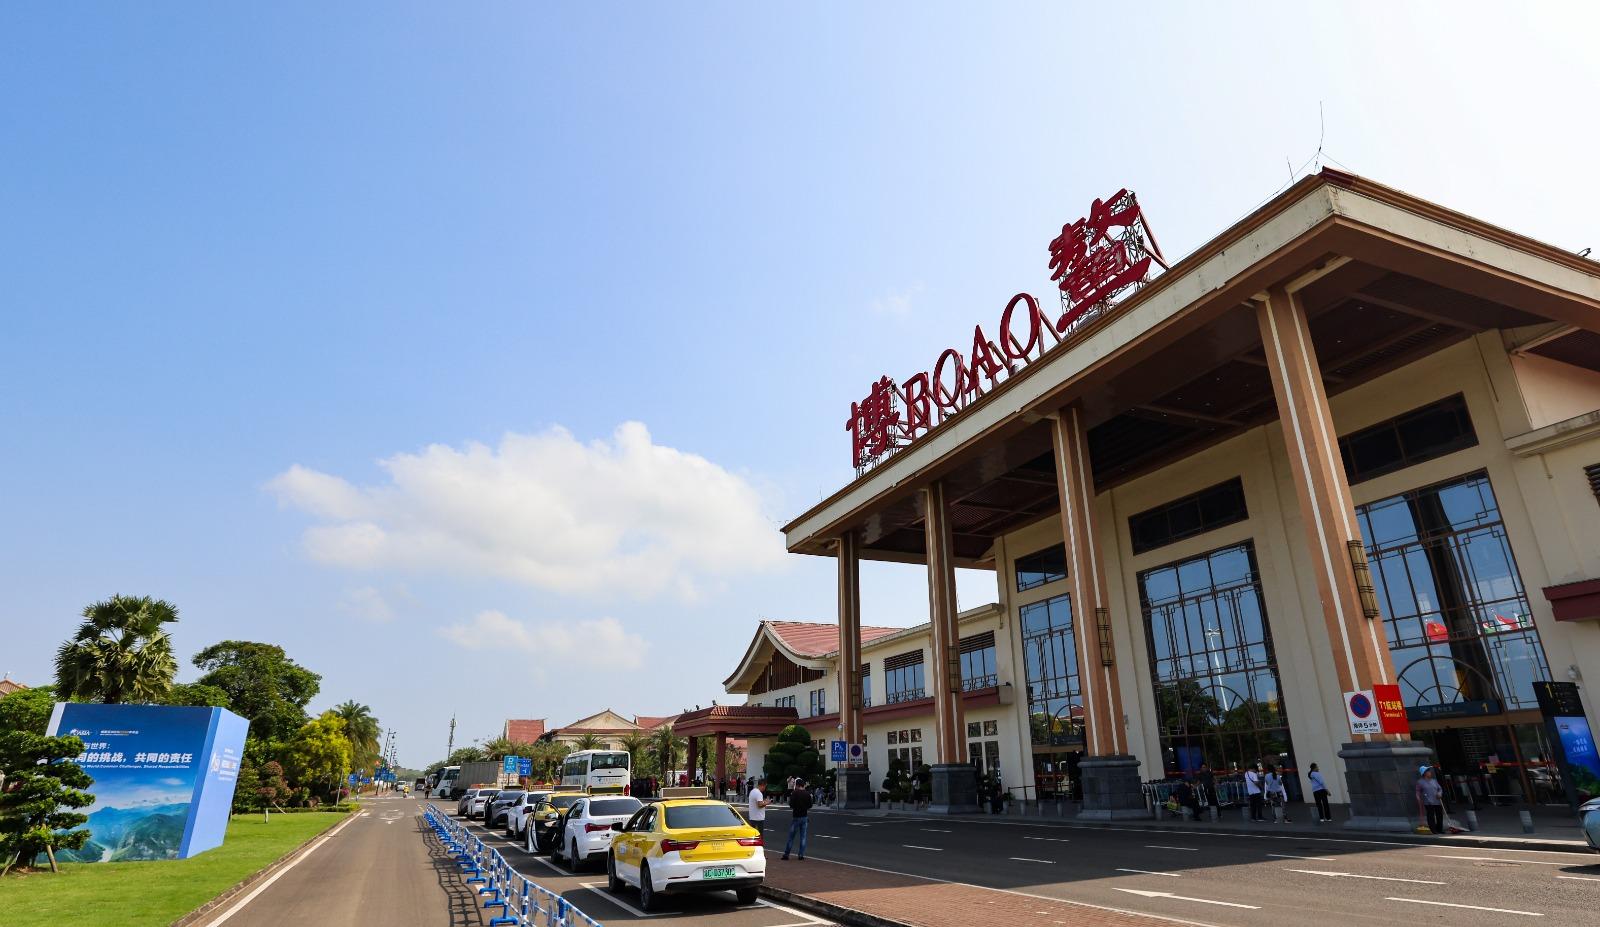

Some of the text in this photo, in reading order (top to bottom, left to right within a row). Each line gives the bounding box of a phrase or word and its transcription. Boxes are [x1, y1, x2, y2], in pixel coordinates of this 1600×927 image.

[846, 375, 900, 468] 博
[902, 292, 1040, 435] BOAO
[1481, 702, 1489, 713] 1
